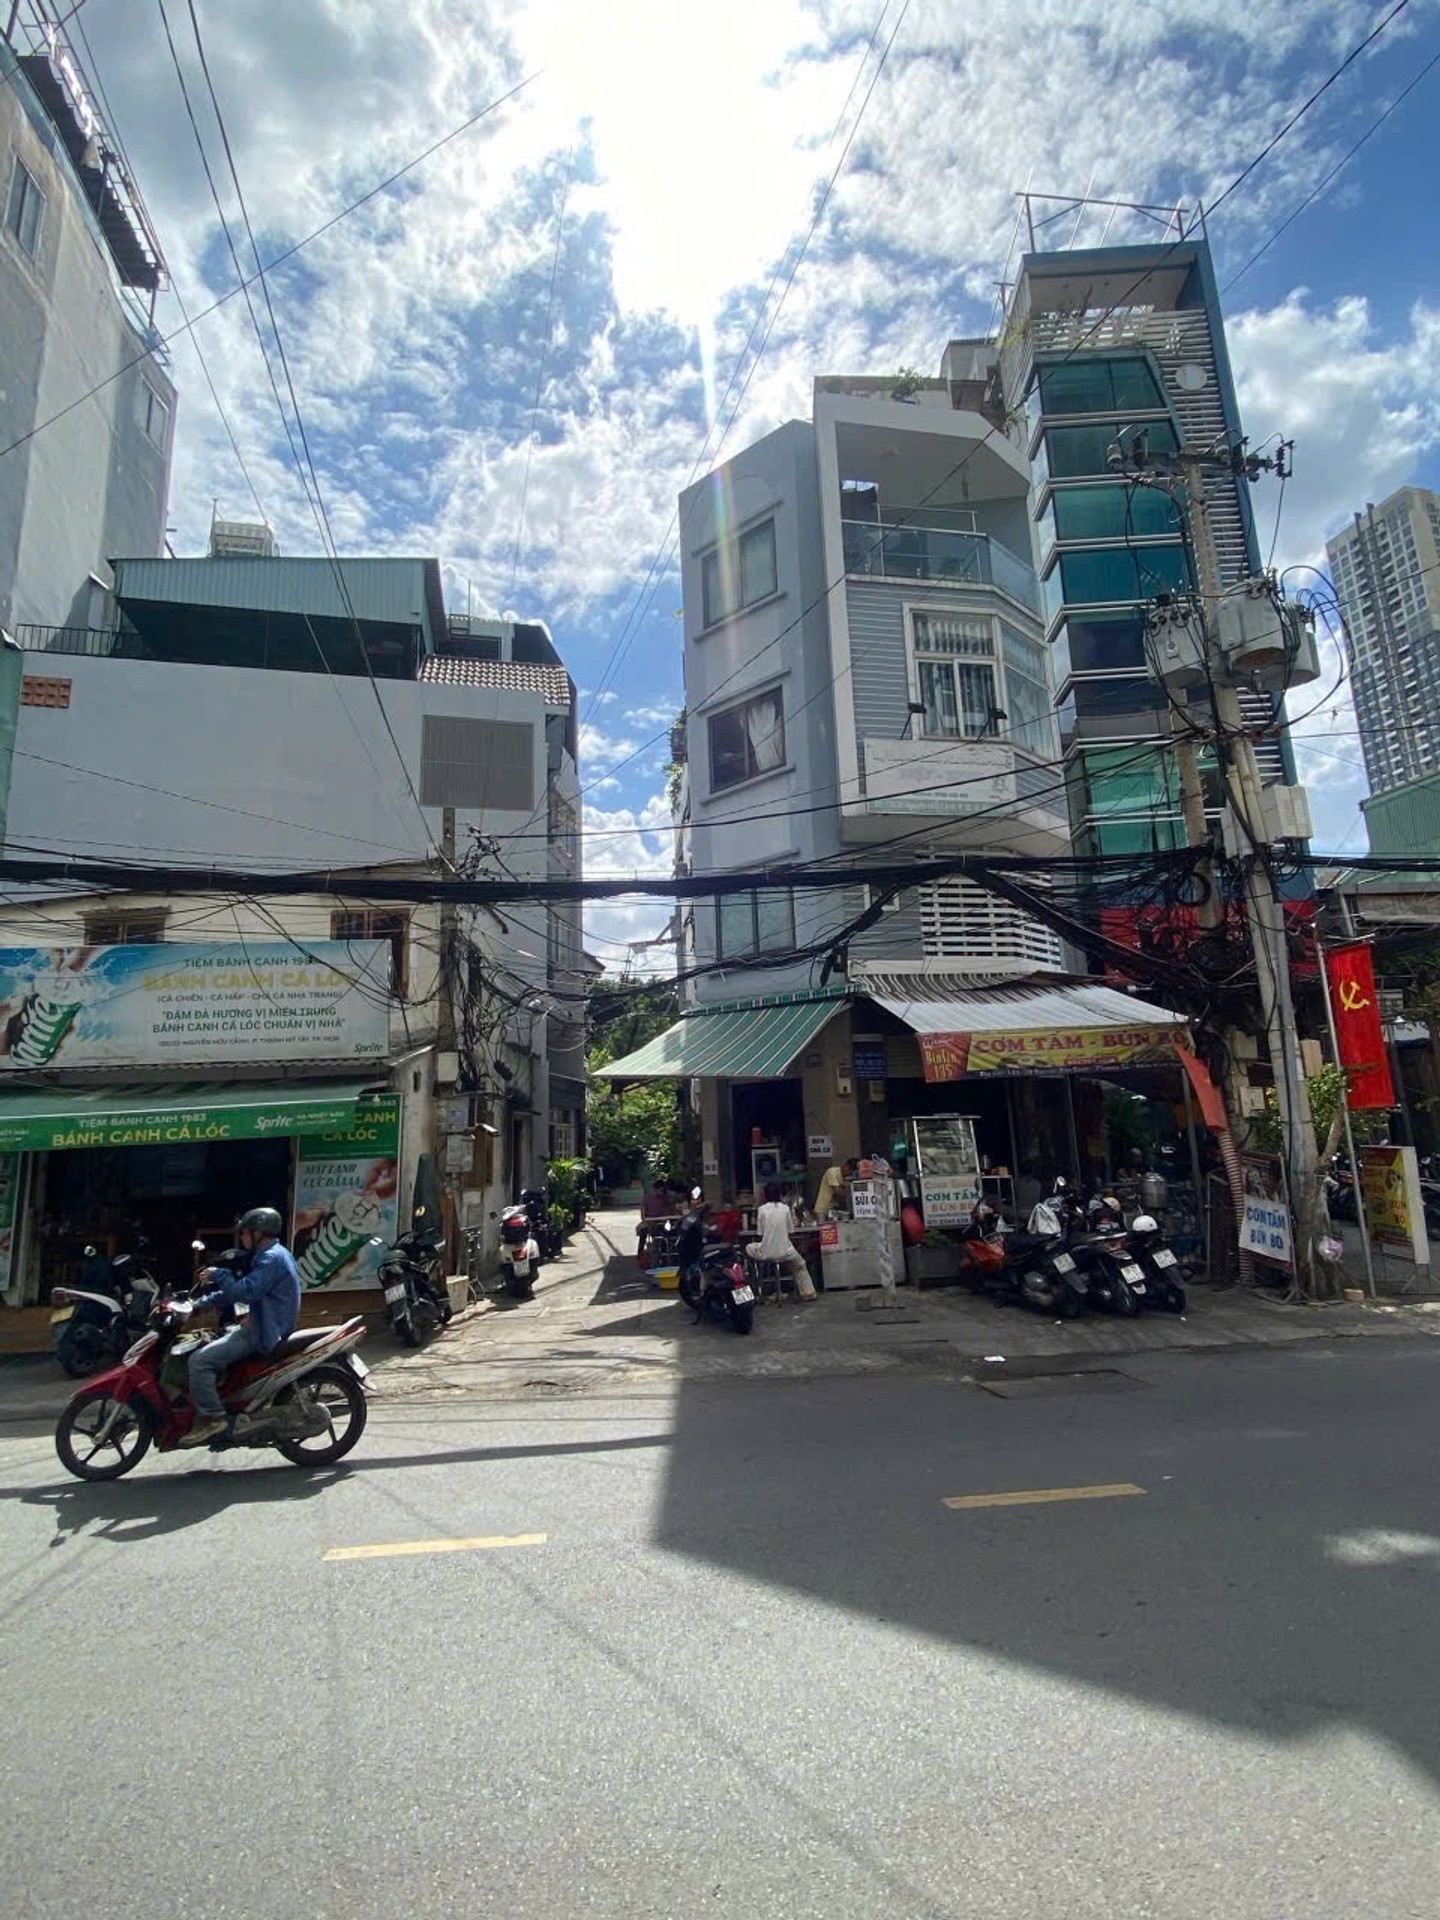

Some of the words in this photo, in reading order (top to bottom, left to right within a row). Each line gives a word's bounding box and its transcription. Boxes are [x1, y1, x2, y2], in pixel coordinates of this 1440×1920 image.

[217, 956, 251, 968] BÁNH
[254, 957, 288, 967] CANH
[213, 1009, 253, 1019] HƯƠNG
[153, 1021, 184, 1033] BÁNH
[187, 1022, 218, 1032] CANH
[221, 1020, 237, 1031] CÁ
[240, 1018, 261, 1031] LÓC
[305, 1018, 316, 1030] VỊ
[353, 1041, 384, 1054] Sprite
[975, 1036, 1025, 1053] CƠM
[110, 1115, 144, 1127] BÁNH
[146, 1114, 178, 1125] CANH
[254, 1115, 294, 1131] Sprite
[53, 1130, 104, 1147] BÁNH
[110, 1129, 160, 1143] CANH
[166, 1124, 191, 1141] CÁ
[196, 1122, 231, 1139] LÓC
[347, 1126, 378, 1141] LÓC
